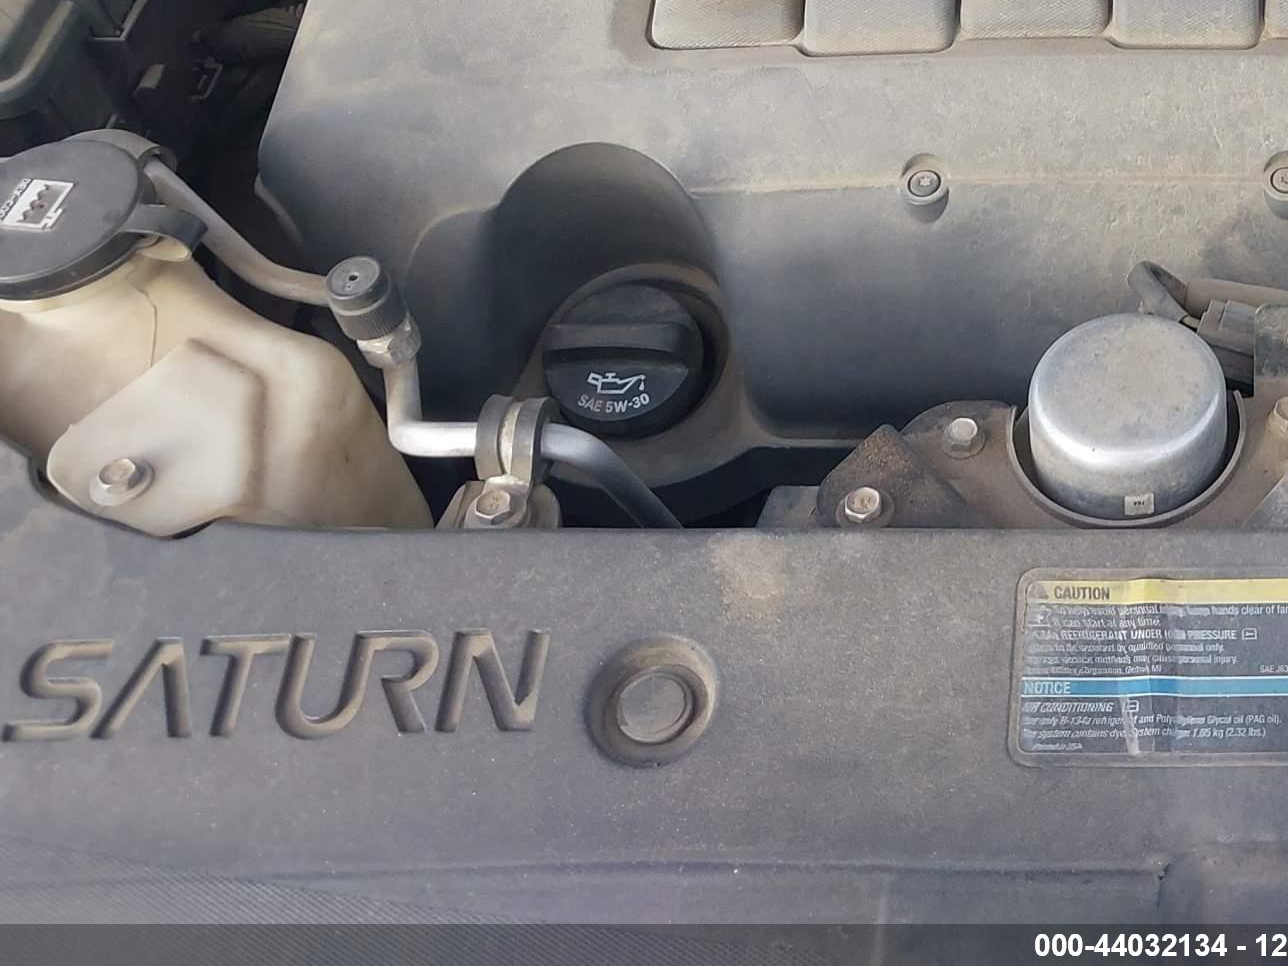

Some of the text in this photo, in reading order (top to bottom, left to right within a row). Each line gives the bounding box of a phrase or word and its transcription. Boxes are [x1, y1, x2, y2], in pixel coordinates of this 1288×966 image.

[577, 393, 650, 413] SAE 5W-30
[1054, 586, 1111, 600] CAUTION
[1241, 605, 1264, 615] clear
[1265, 605, 1276, 615] of
[1117, 618, 1136, 629] any
[1130, 629, 1162, 639] UNDER
[1128, 642, 1164, 654] qualified
[1260, 664, 1275, 673] SAE
[3, 628, 551, 743] SATURN
[1024, 681, 1072, 695] NOTICE
[1041, 701, 1115, 713] CONDITIONING
[1139, 714, 1155, 724] and
[1233, 714, 1245, 724] oil
[1246, 714, 1266, 725] (PAG
[1213, 728, 1225, 740] kg
